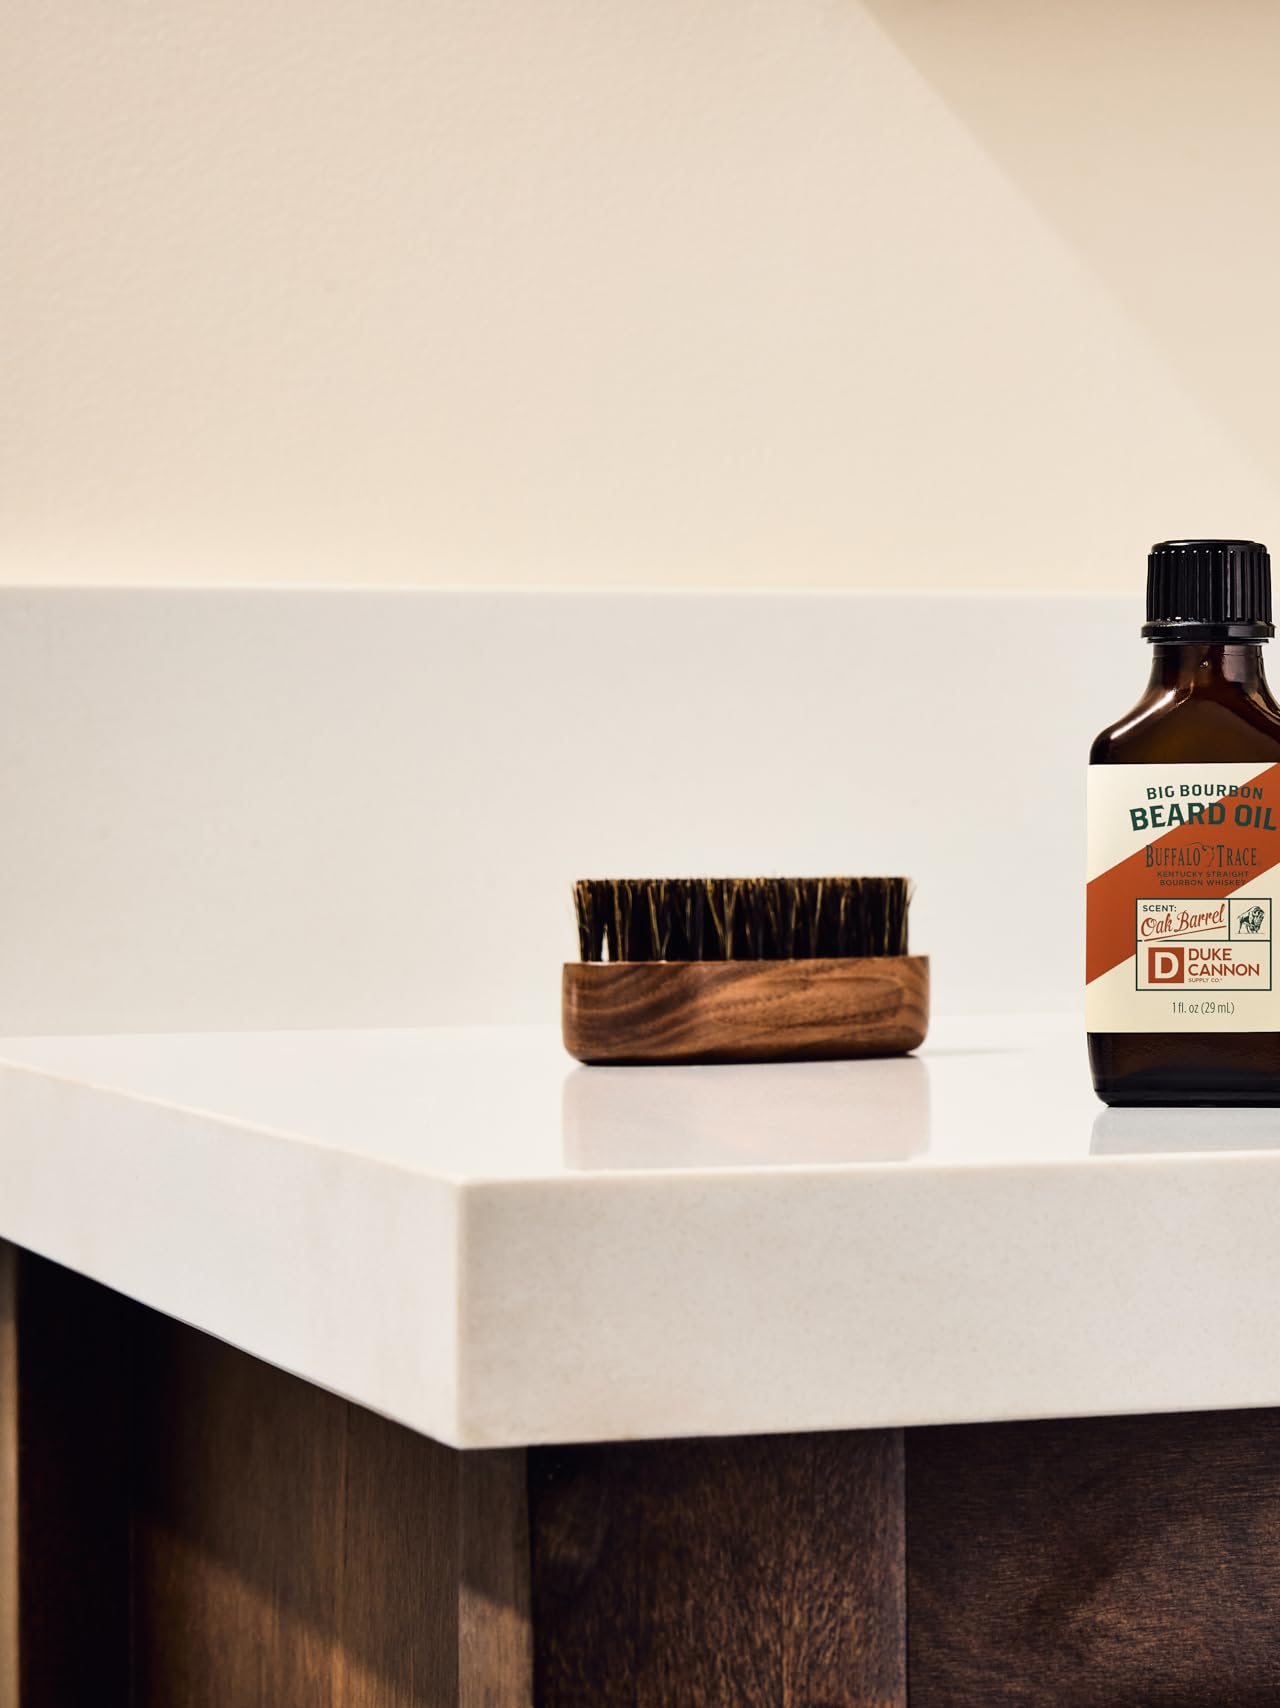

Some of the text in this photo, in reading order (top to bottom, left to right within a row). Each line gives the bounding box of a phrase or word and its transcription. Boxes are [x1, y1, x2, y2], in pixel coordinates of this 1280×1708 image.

[1146, 784, 1264, 801] BIG BOURBON
[1129, 802, 1278, 832] BEARD OIL
[1145, 844, 1201, 868] BUFFALO
[1142, 904, 1177, 912] SCENT:
[1140, 903, 1226, 937] Oak Barrel
[1188, 948, 1233, 961] DUKE
[1154, 951, 1180, 979] D
[1188, 963, 1260, 977] CANNON
[1172, 1001, 1235, 1015] 1 fl. oz (29 mL)
